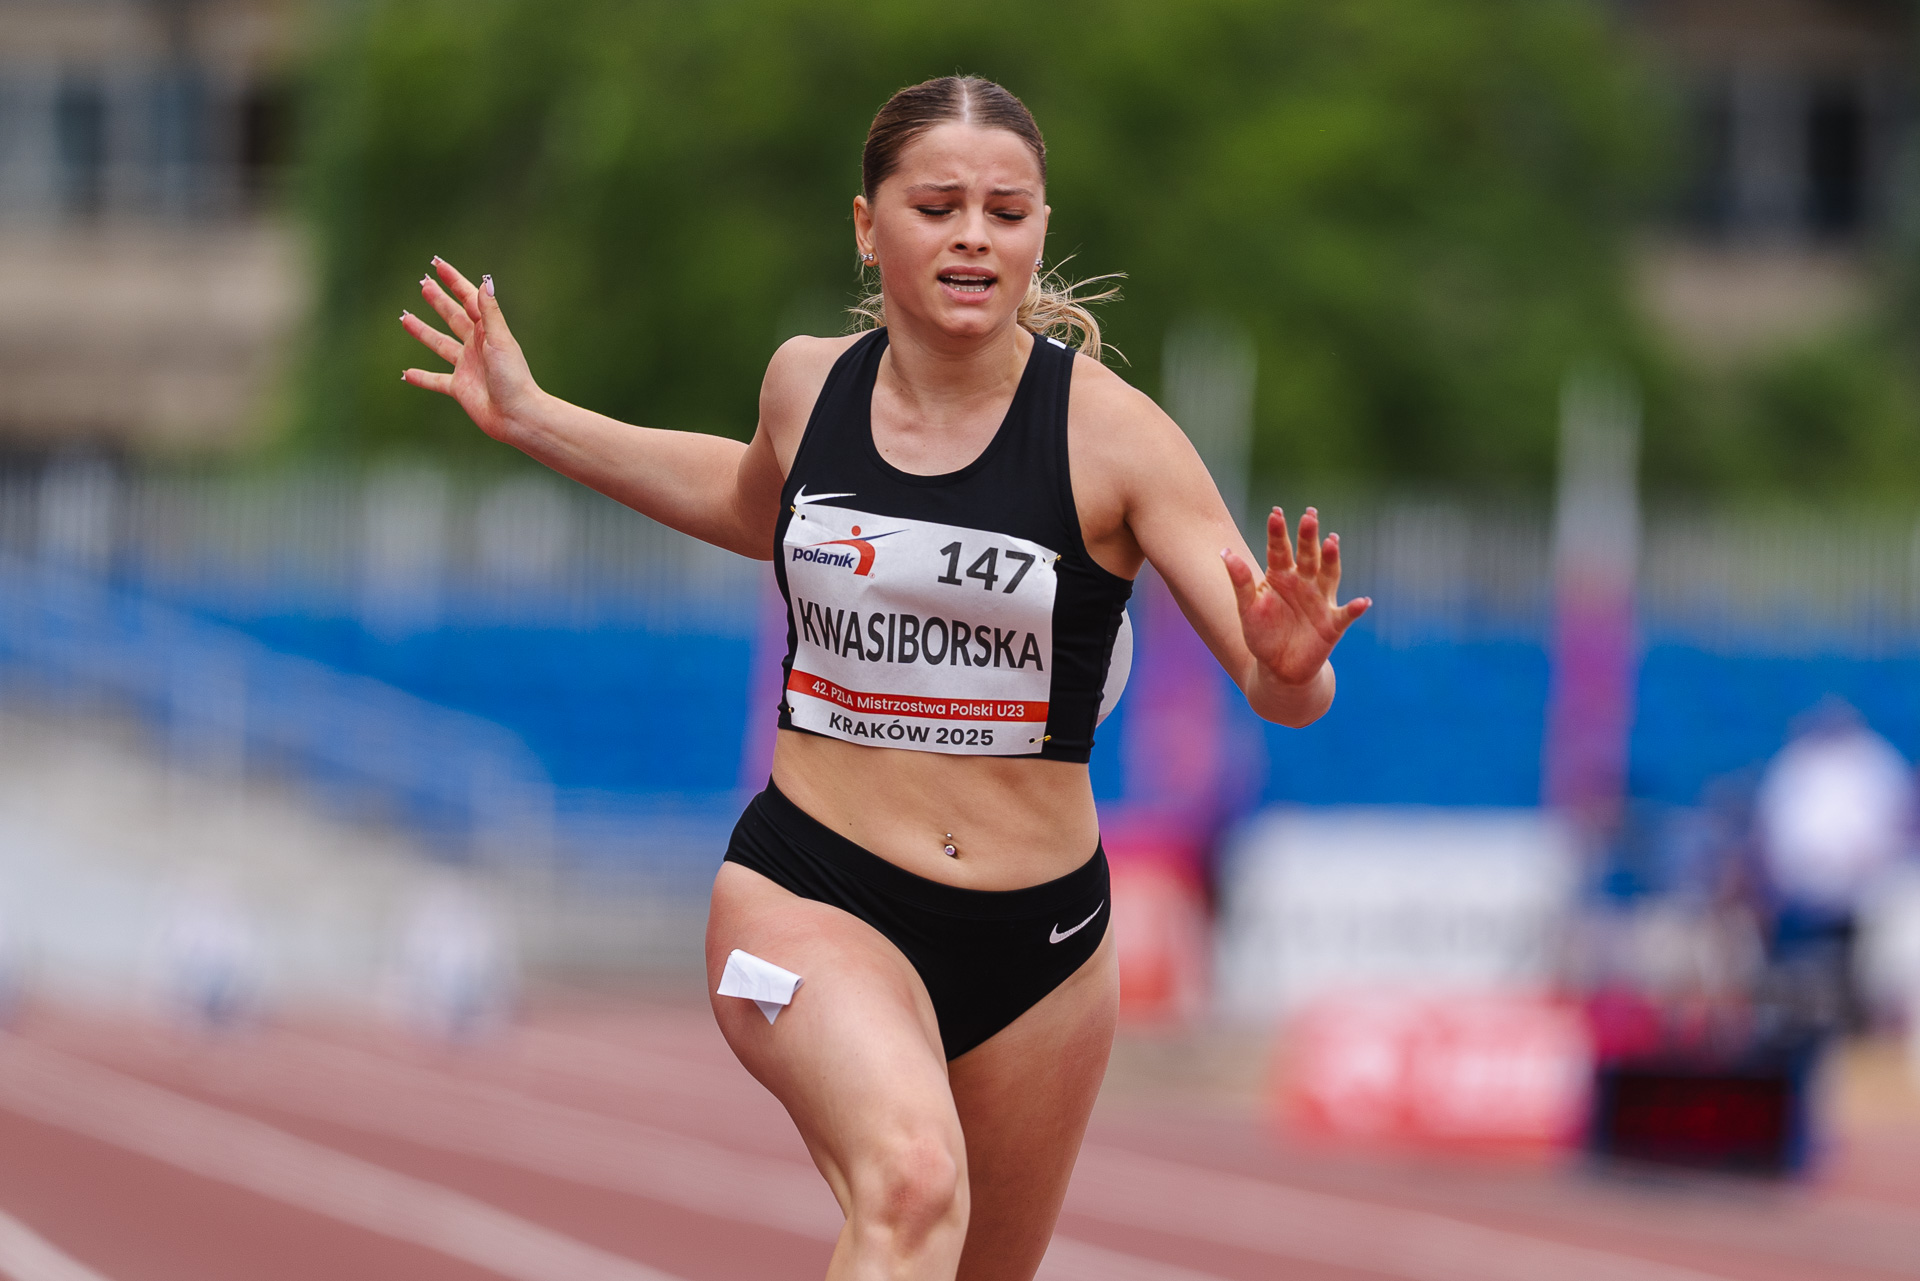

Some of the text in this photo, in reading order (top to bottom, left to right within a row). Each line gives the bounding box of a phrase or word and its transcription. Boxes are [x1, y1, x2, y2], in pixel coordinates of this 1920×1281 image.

[792, 547, 855, 569] polanik
[937, 541, 1036, 594] 147
[797, 597, 1044, 671] KWASIBORSKA
[812, 681, 1025, 717] 42. PZLA Mistrzostwa Polski U23
[829, 712, 994, 745] KRAKÓW 2025
